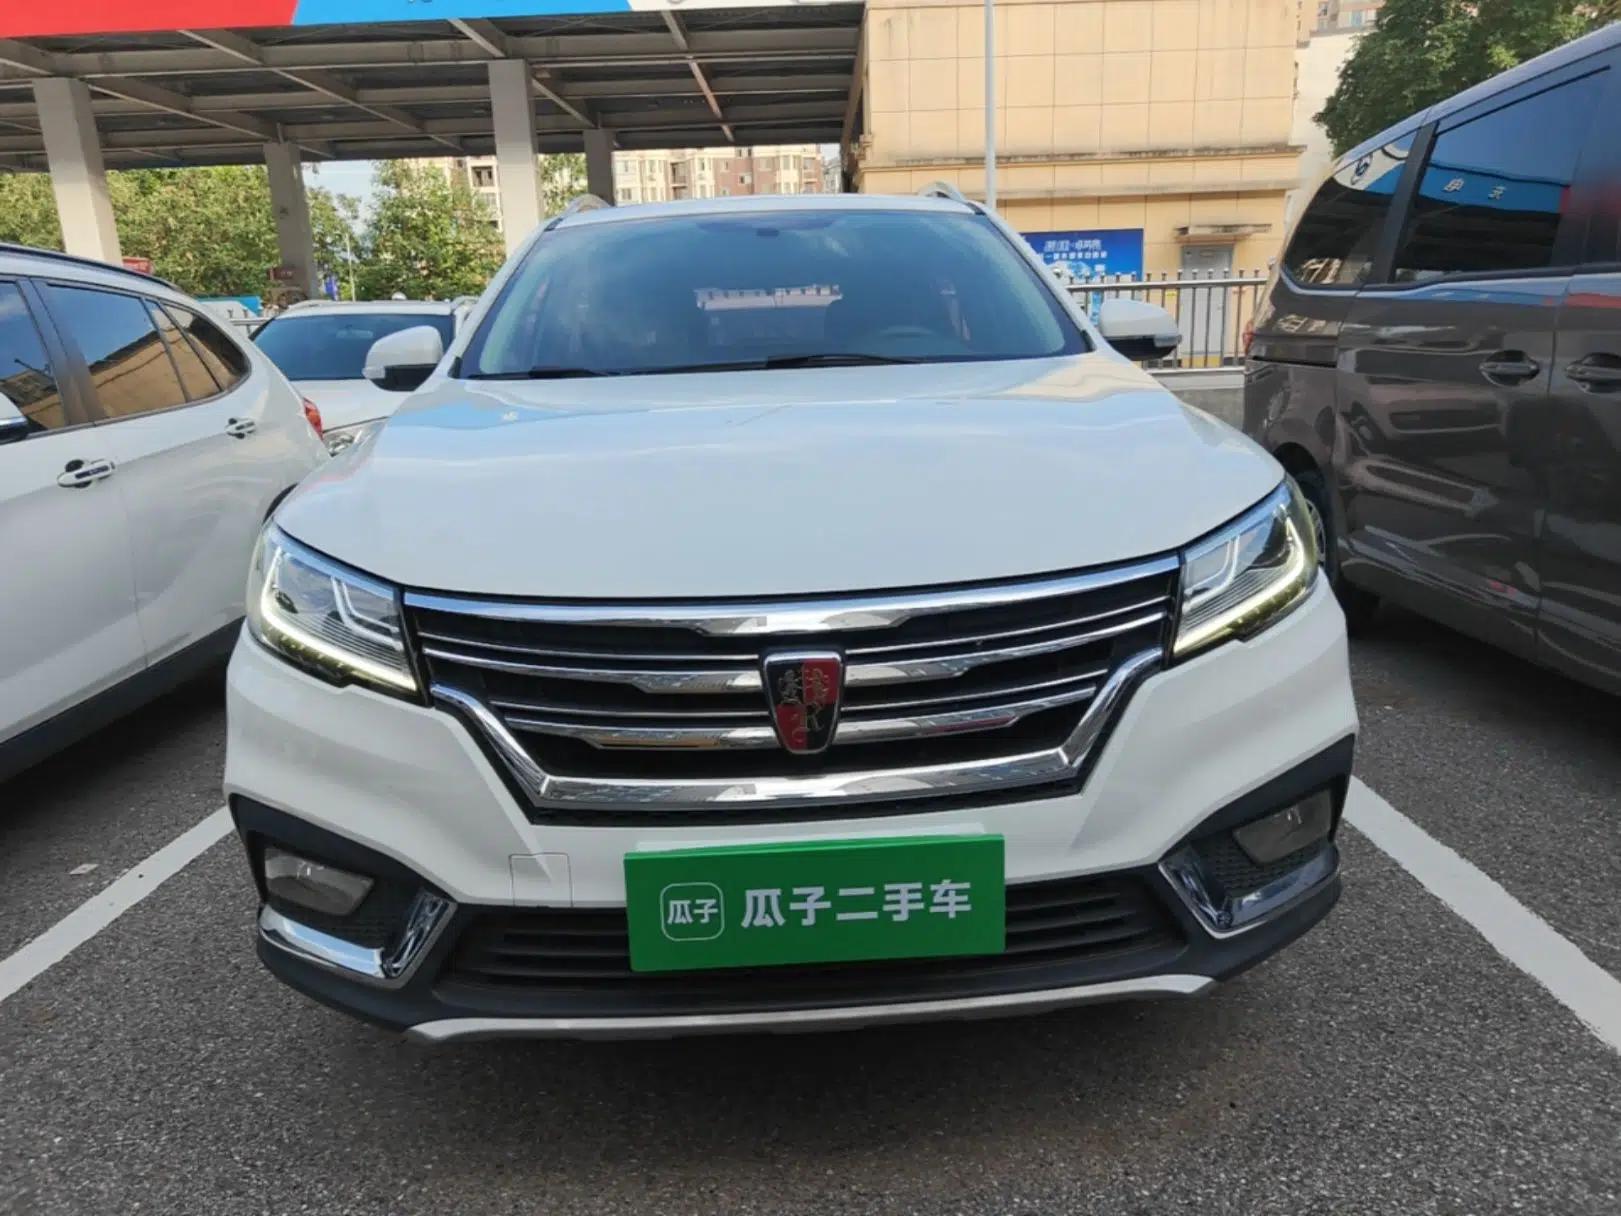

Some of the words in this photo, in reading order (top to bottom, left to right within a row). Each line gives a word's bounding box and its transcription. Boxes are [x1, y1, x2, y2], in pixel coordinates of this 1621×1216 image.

[667, 898, 719, 925] 瓜子
[741, 879, 972, 929] 瓜子二手车
